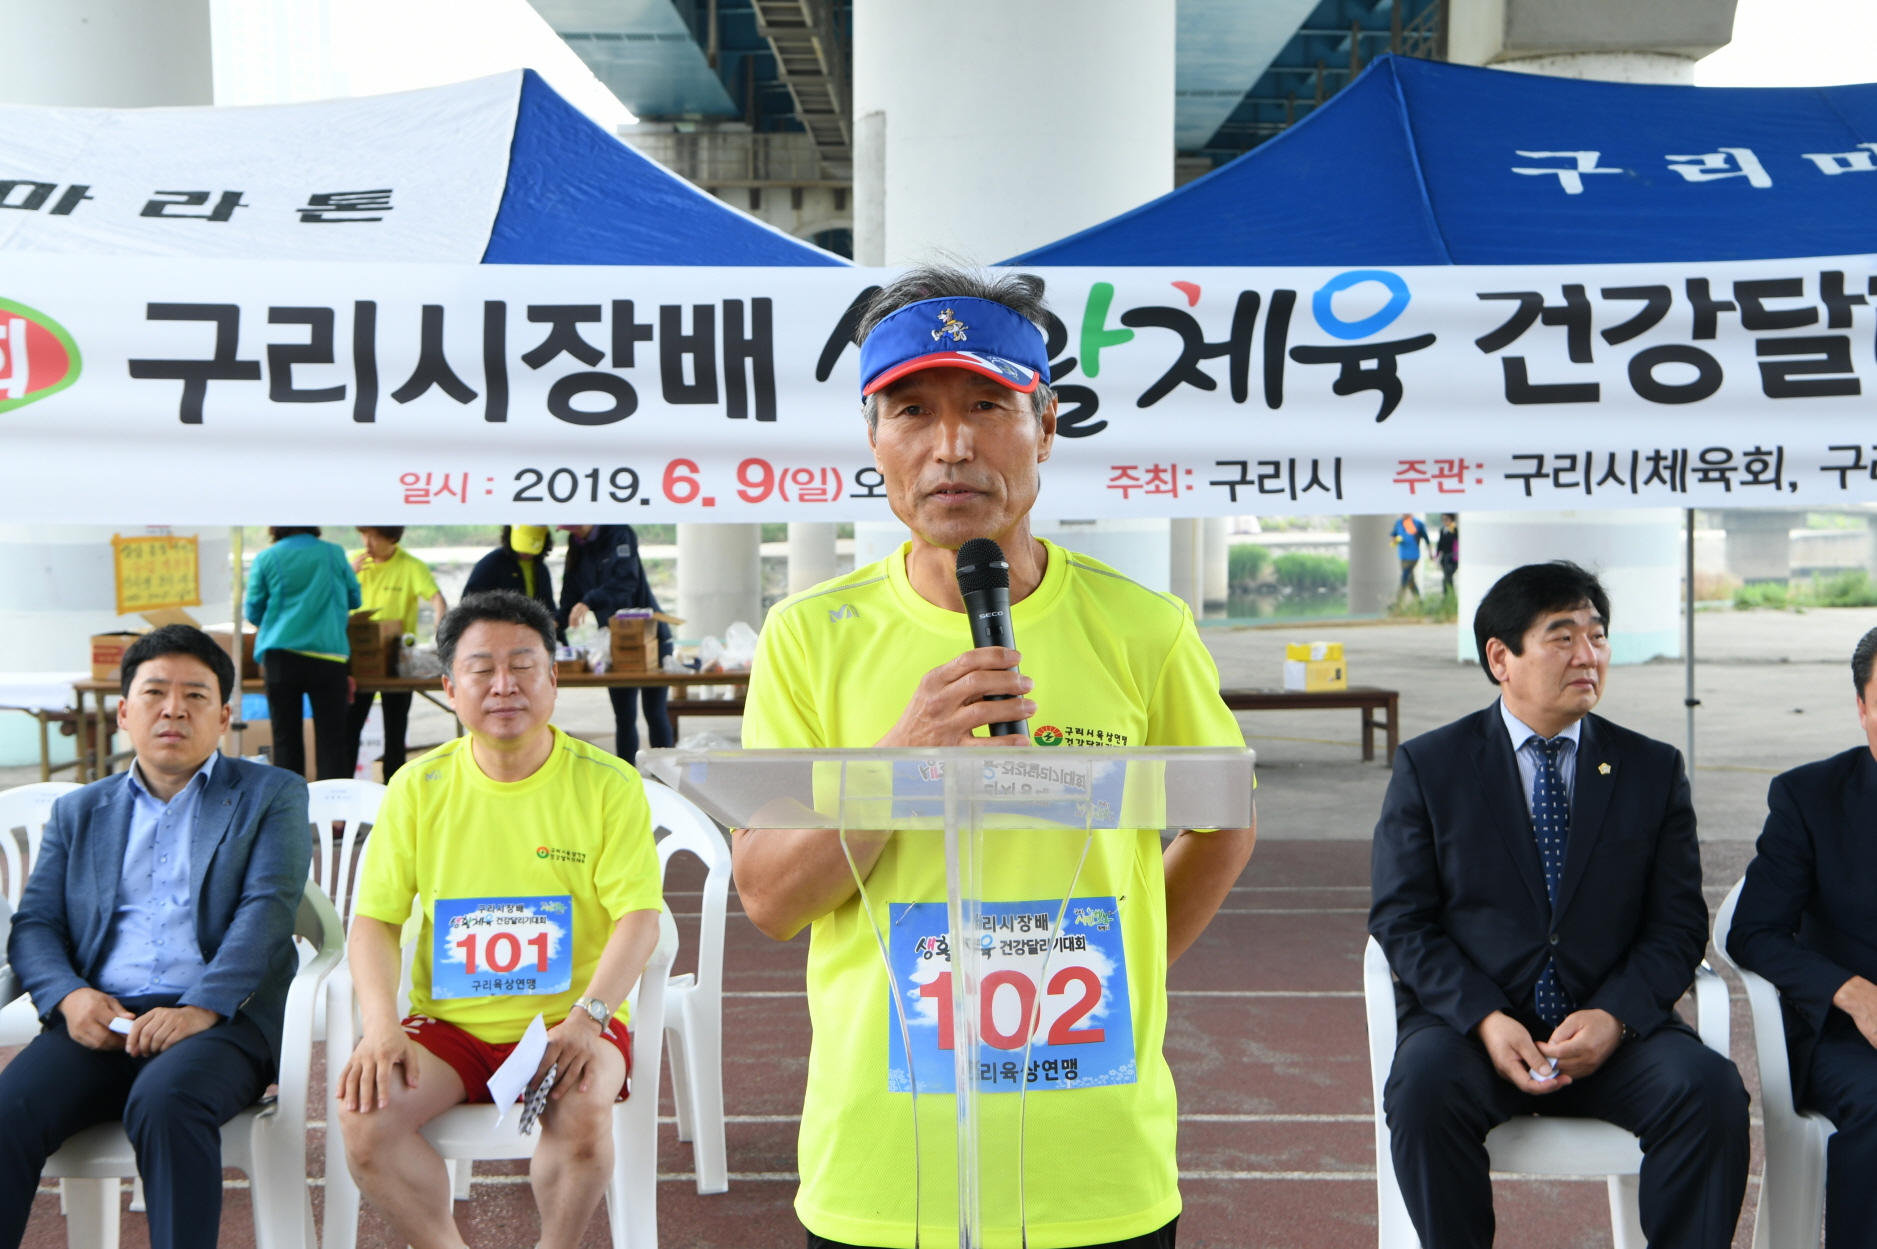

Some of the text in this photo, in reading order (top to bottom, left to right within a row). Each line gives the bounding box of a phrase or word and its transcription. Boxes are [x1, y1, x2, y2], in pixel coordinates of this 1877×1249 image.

[128, 297, 777, 426] 구리시장배
[1475, 270, 1877, 406] 건강달
[1107, 464, 1193, 499] 주최:
[1209, 459, 1343, 502] 구리시
[1393, 459, 1485, 495] 주관:
[1820, 446, 1877, 490] 구
[478, 904, 524, 914] 구리시장배
[496, 916, 547, 925] 건강달리기대회
[974, 913, 1049, 934] 리시장배
[456, 932, 548, 974] 101
[472, 978, 537, 992] 구리육상연맹
[920, 966, 1105, 1050] 102
[967, 1058, 1079, 1083] 리육상연맹
